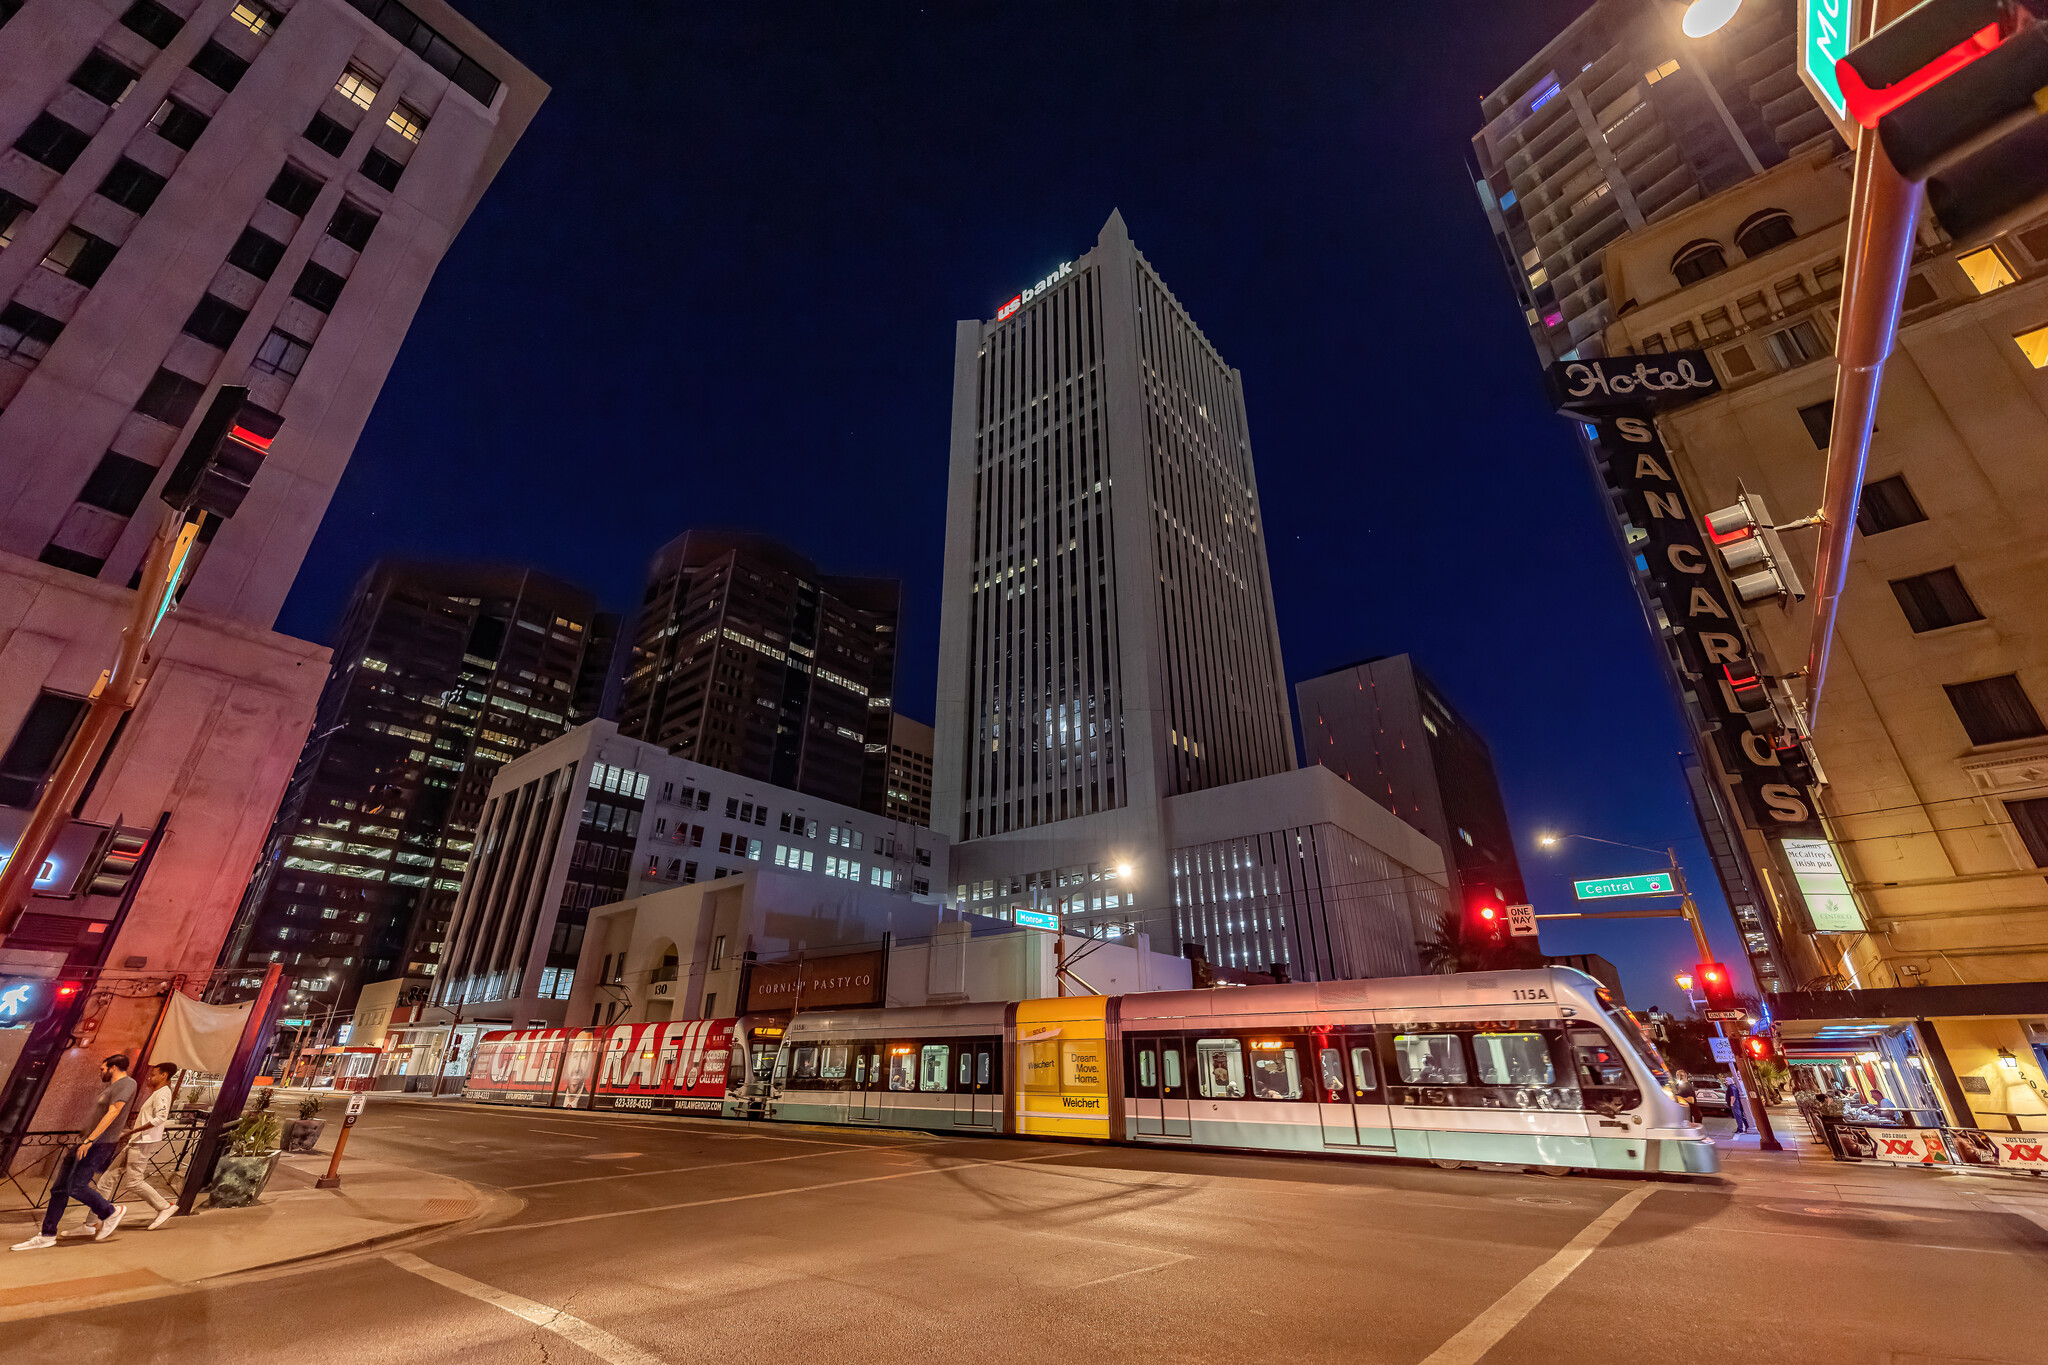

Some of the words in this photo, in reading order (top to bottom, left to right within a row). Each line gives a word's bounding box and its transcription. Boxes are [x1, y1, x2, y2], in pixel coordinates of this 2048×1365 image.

[1021, 261, 1073, 305] bank
[1565, 358, 1714, 397] Hotel
[1615, 417, 1687, 520] SAN
[1788, 851, 1832, 859] McCaffrey's
[1585, 881, 1634, 895] Central
[1510, 907, 1530, 916] ONE
[1020, 913, 1043, 924] Monroe
[1512, 915, 1532, 925] WAY
[814, 976, 852, 990] PASTY
[855, 974, 871, 986] CO
[655, 984, 668, 995] 130
[1512, 988, 1549, 1000] 115A
[1071, 1053, 1099, 1063] Dream.
[1075, 1063, 1099, 1073] Move.
[1074, 1074, 1099, 1084] Home.
[1062, 1097, 1100, 1108] Weichert
[1880, 1139, 1920, 1156] XX
[2001, 1143, 2048, 1163] XX
